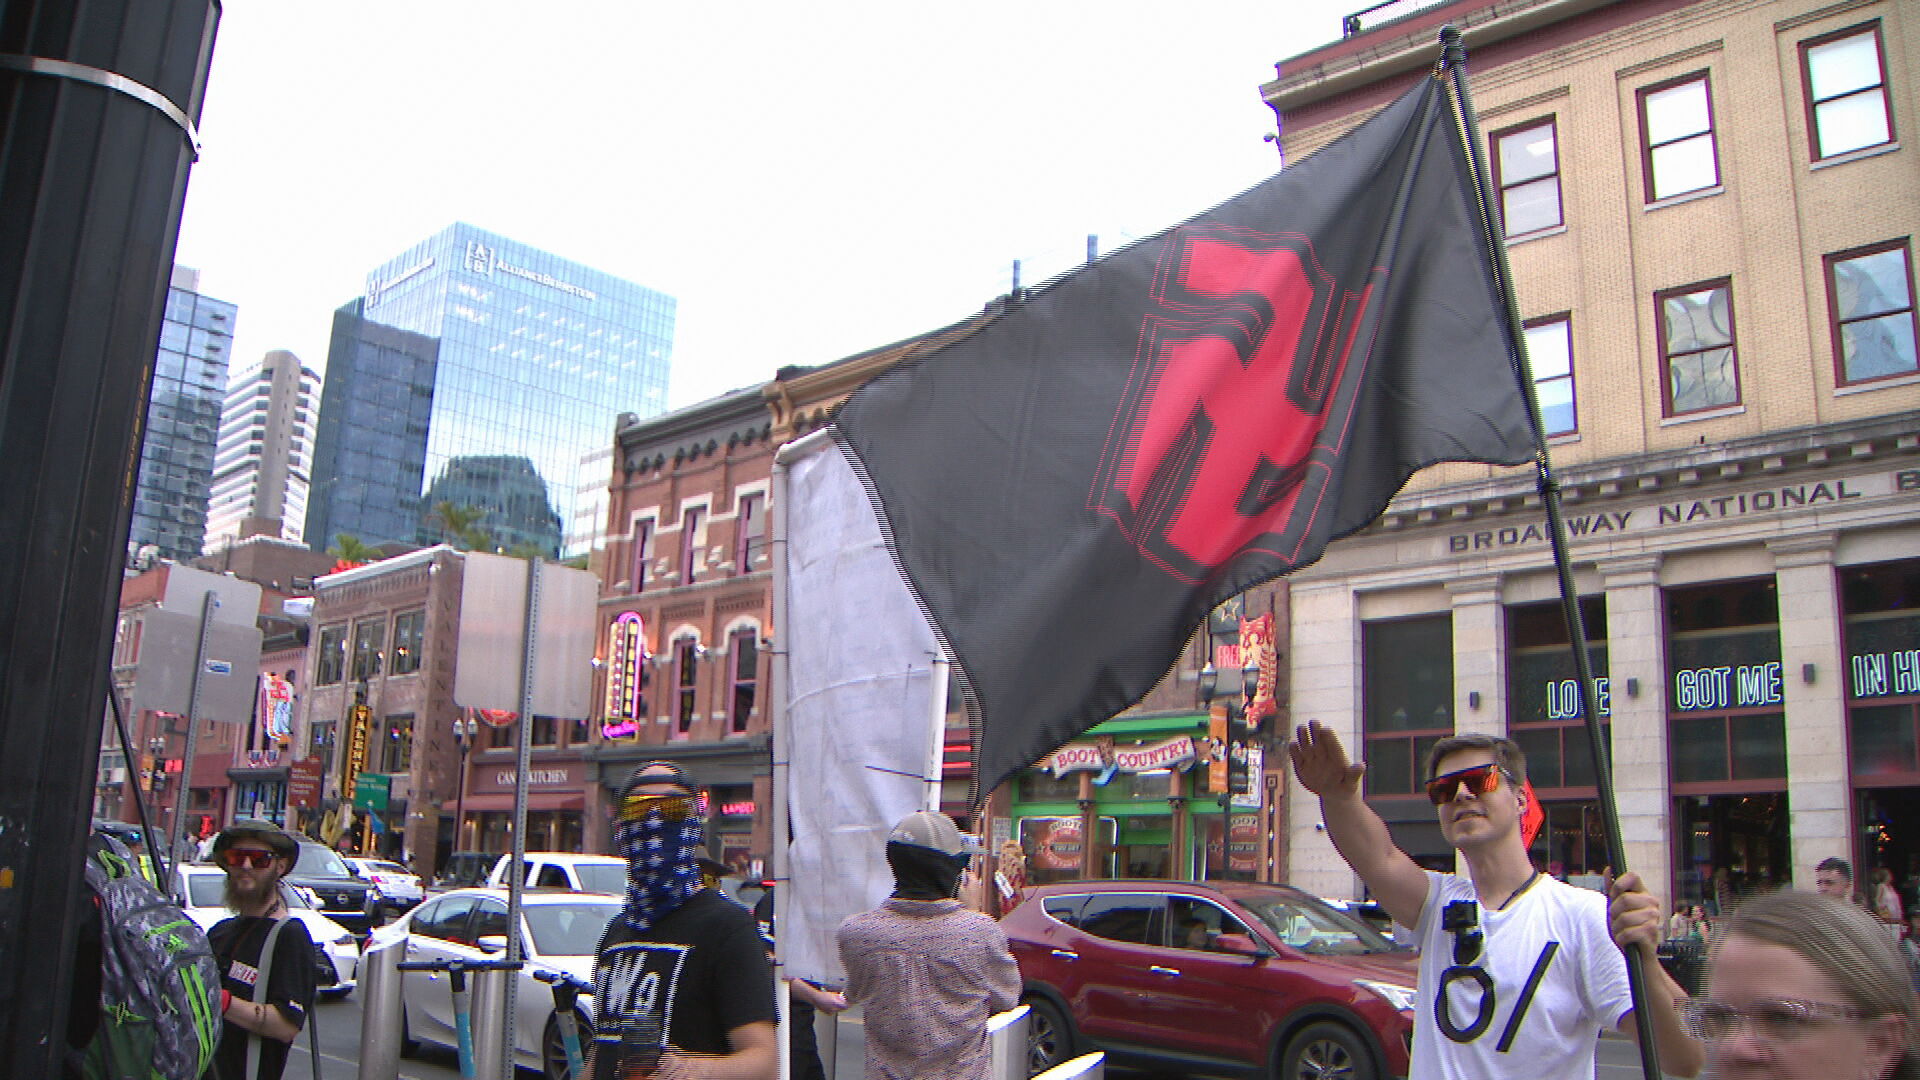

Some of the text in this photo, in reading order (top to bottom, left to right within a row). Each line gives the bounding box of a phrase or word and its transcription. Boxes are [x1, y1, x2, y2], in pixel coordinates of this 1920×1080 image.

[1449, 510, 1633, 553] BROAWAY
[1659, 480, 1861, 524] NATIONAL
[1547, 679, 1610, 719] LOE
[1676, 666, 1732, 710] GOT
[1737, 662, 1782, 706] ME
[1852, 653, 1890, 697] IN
[1057, 738, 1189, 769] BOOT COUNTRY
